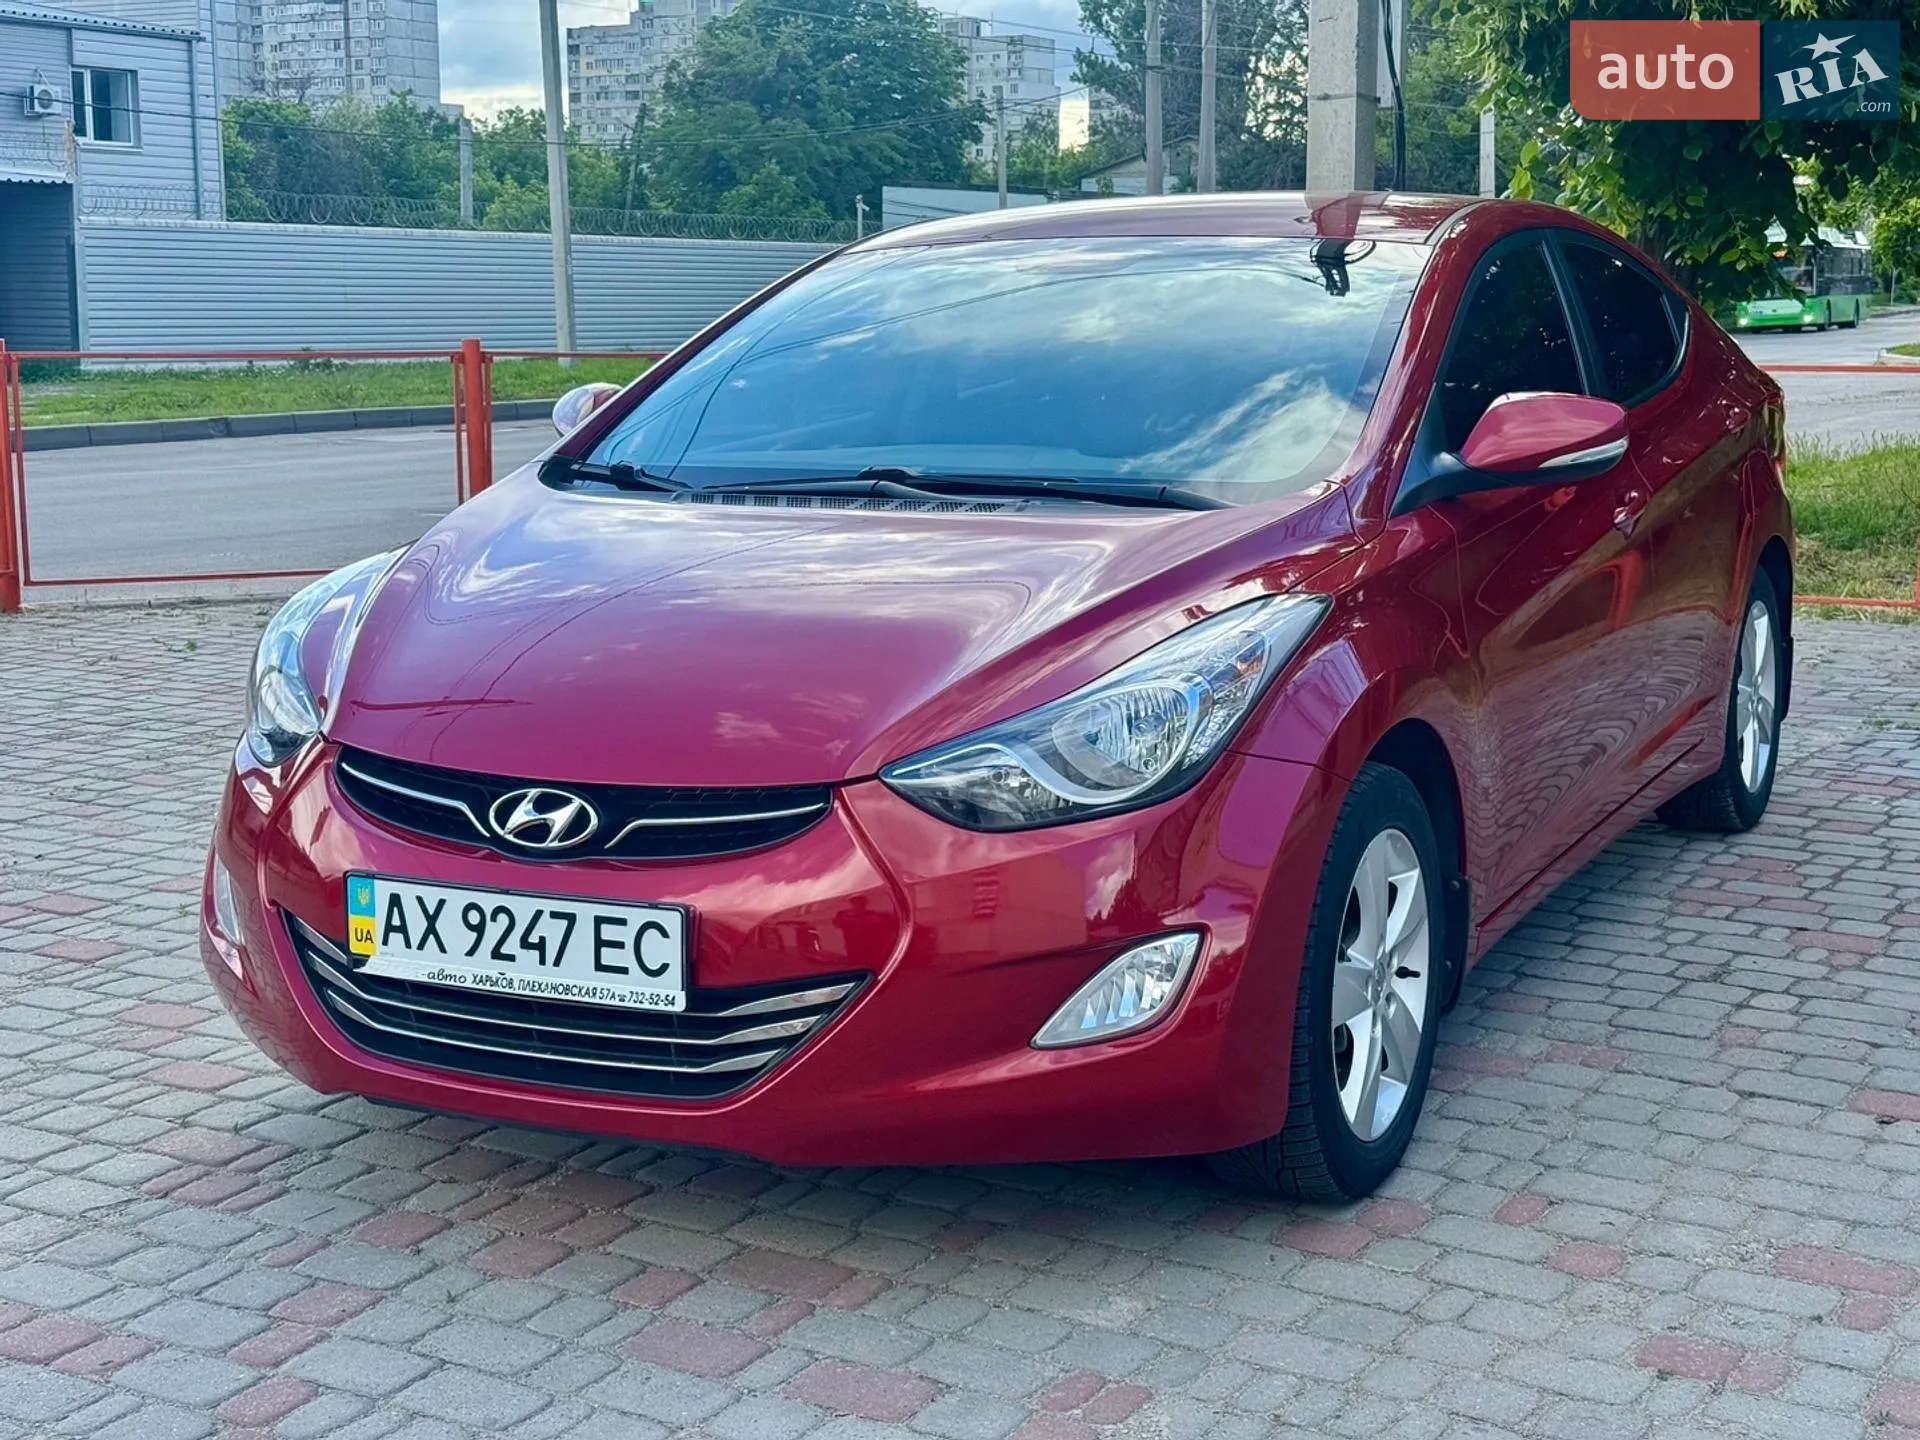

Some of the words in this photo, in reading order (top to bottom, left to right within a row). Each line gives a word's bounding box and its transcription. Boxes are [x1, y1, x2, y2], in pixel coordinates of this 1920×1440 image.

[354, 927, 374, 944] UA
[381, 893, 448, 954] AX
[461, 902, 577, 967] 9247
[593, 914, 671, 978] EC
[628, 991, 676, 1007] 732-52-54
